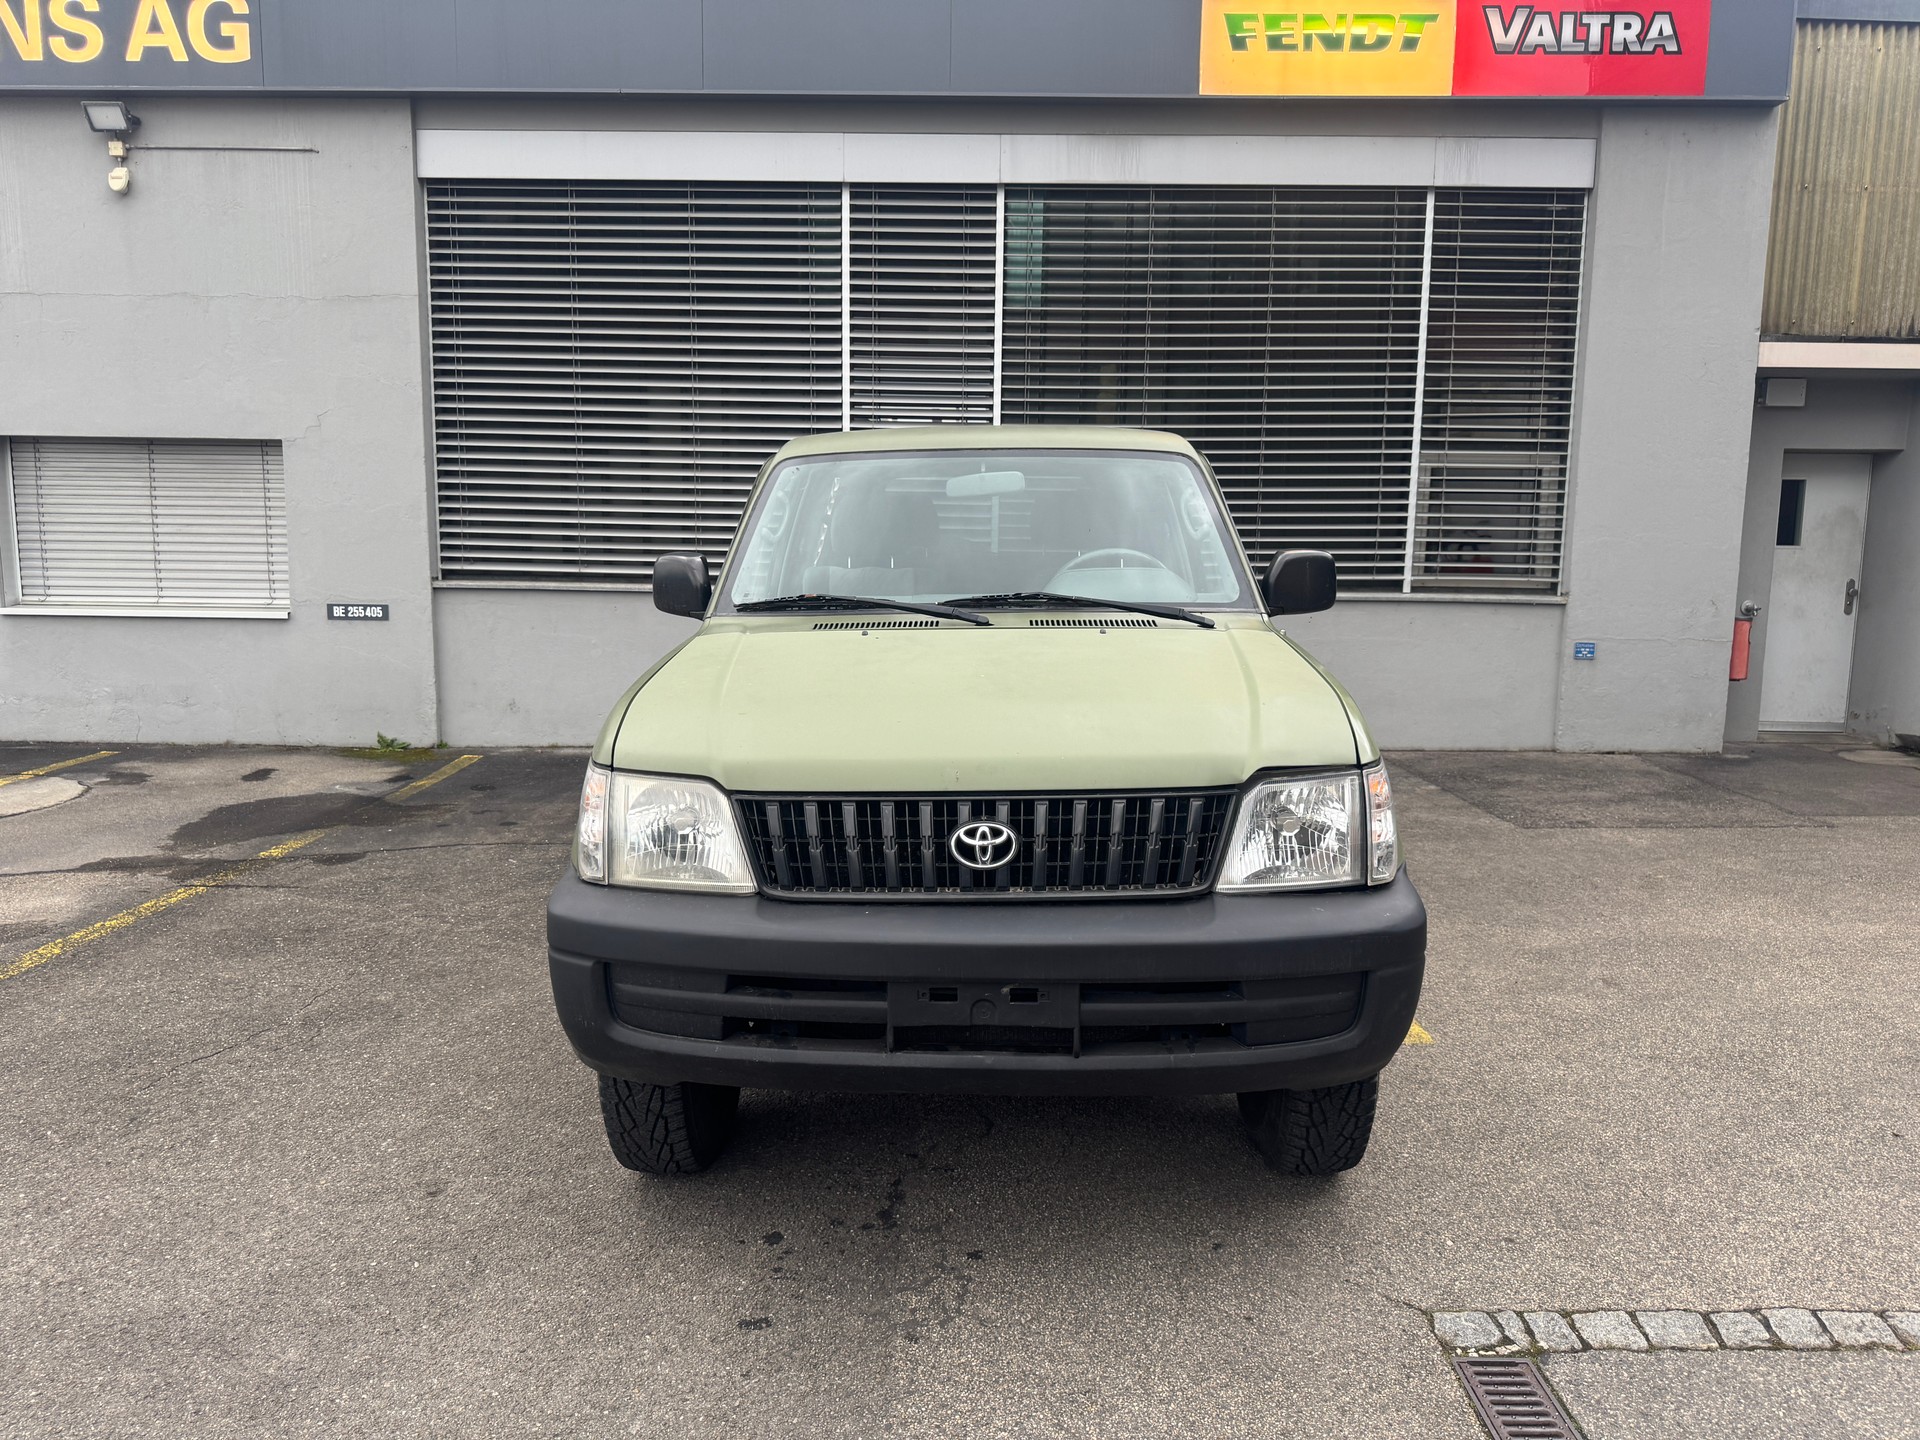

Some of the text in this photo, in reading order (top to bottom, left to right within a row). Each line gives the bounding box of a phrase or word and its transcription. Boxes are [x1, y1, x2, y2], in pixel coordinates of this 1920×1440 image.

[125, 0, 251, 64] AG
[1223, 13, 1440, 52] FENDT
[1482, 4, 1683, 55] VALTRA
[333, 605, 346, 617] BE
